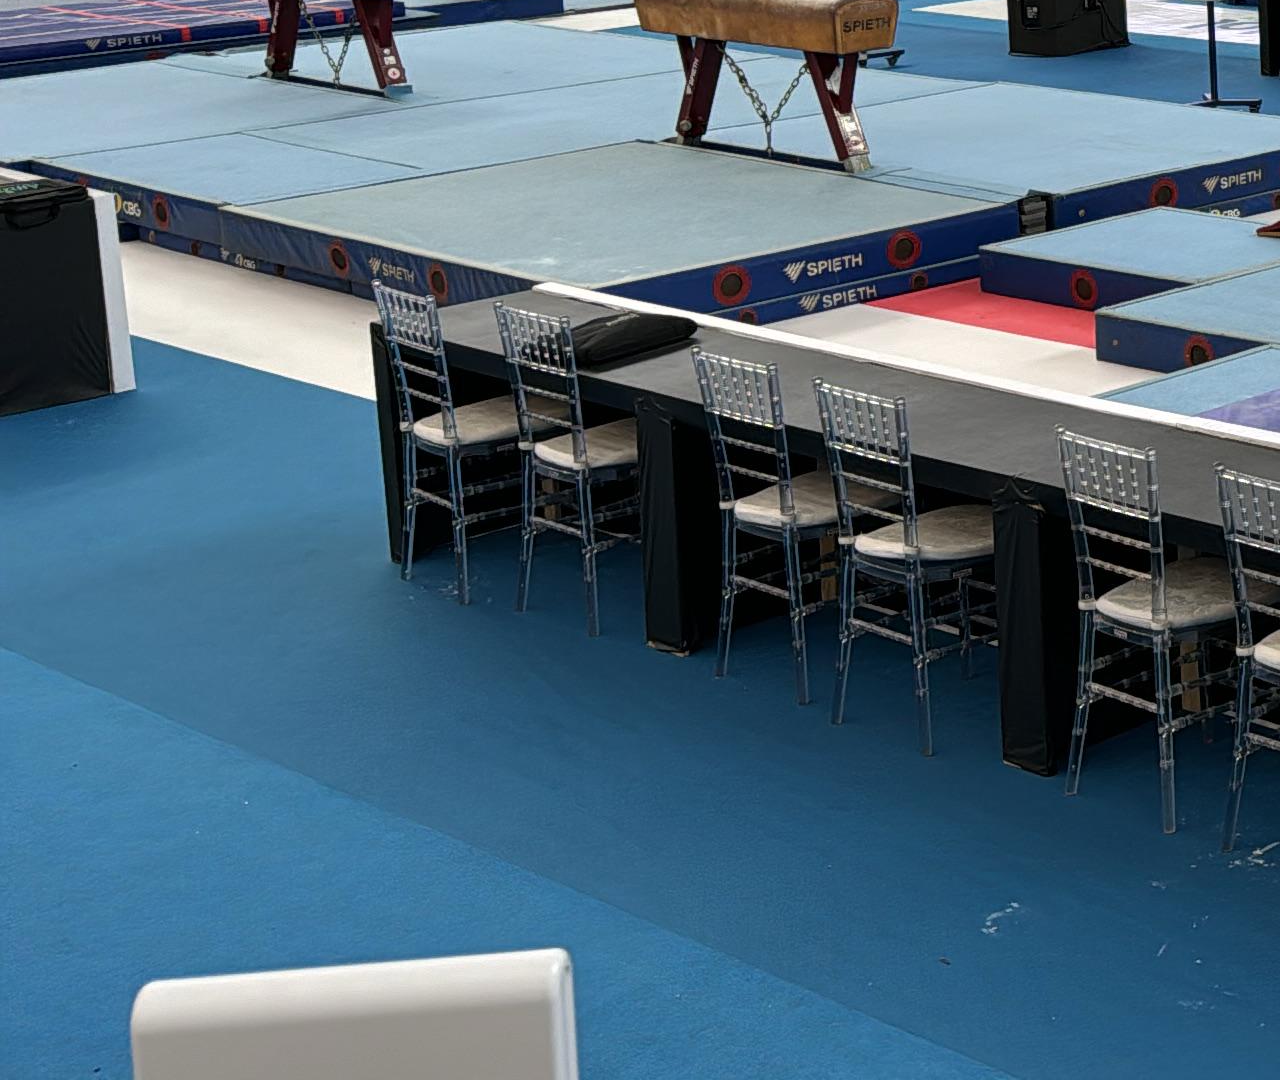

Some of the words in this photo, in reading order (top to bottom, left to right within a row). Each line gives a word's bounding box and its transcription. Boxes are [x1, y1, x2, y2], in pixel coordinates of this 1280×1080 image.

[843, 16, 892, 33] SPIETH
[106, 33, 163, 48] SPIETH
[1220, 168, 1262, 190] SPIETH
[122, 200, 142, 217] CBG
[806, 253, 863, 277] SPIETH
[822, 284, 878, 308] SPIETH
